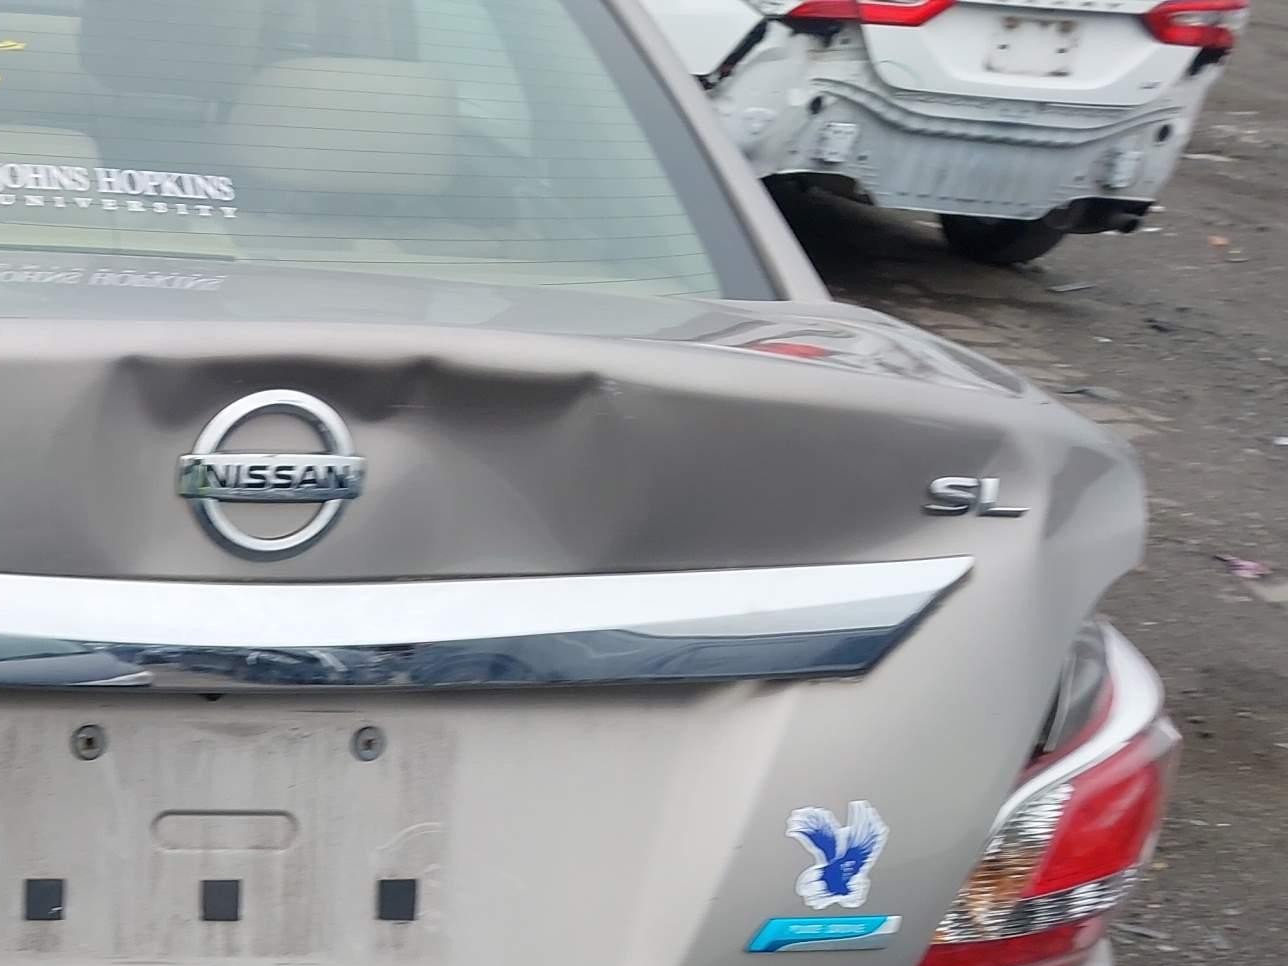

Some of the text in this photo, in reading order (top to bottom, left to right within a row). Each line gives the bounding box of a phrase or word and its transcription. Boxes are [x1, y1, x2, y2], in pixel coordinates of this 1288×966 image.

[93, 168, 236, 201] HOPKINS
[200, 463, 349, 490] NISSAN
[921, 476, 1031, 517] SL
